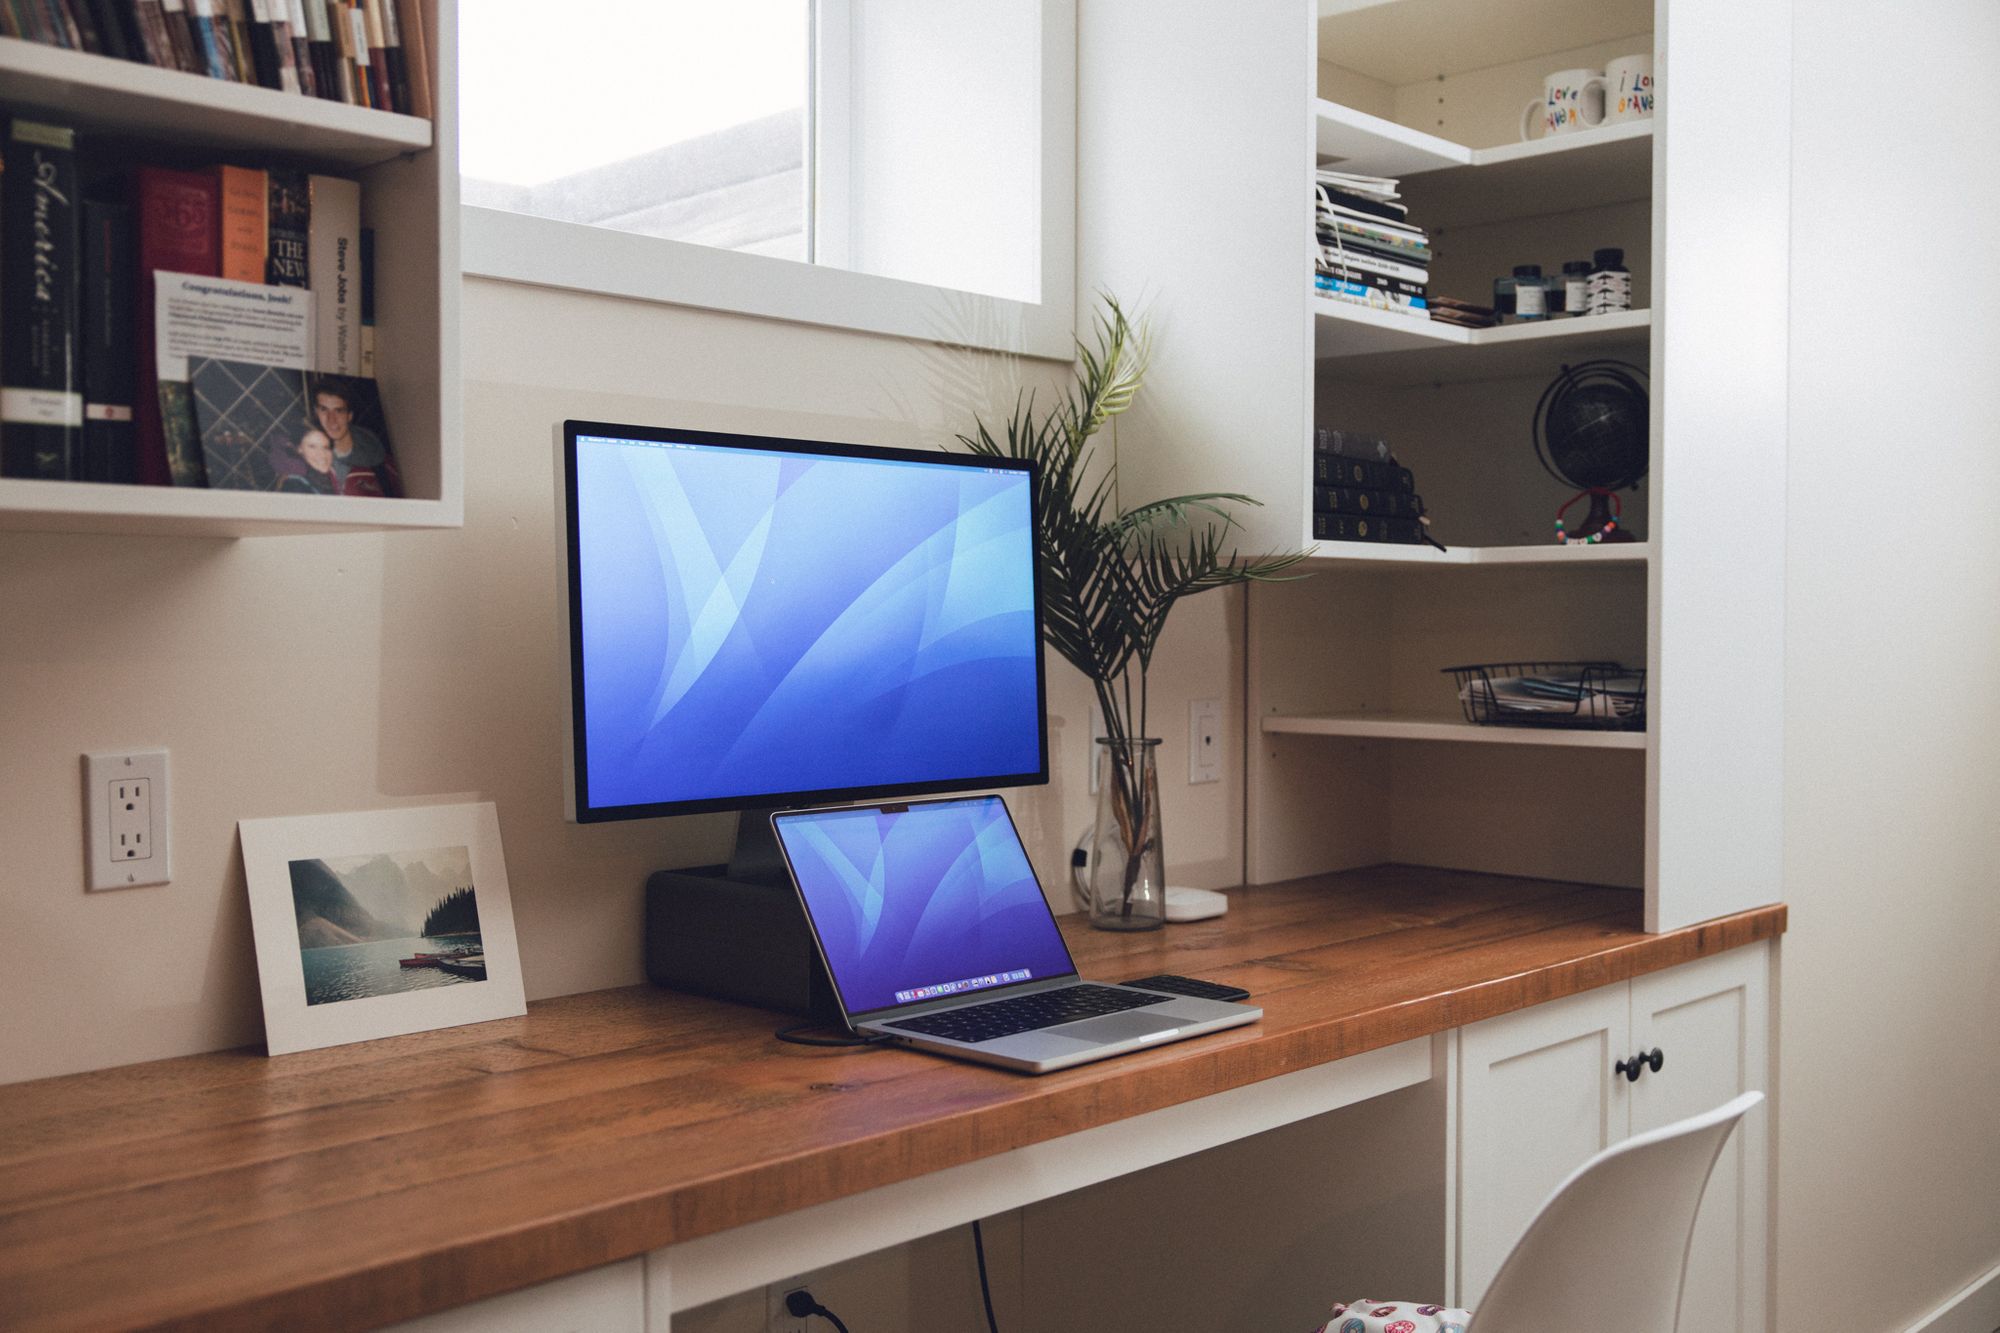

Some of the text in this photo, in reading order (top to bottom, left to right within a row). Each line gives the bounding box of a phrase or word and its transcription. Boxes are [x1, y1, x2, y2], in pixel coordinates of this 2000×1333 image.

[1548, 85, 1578, 106] Love
[34, 151, 69, 300] America
[275, 239, 305, 259] THE
[337, 236, 347, 272] Steve
[182, 281, 266, 301] Congratulations,
[337, 274, 347, 304] Jobs
[336, 307, 346, 321] by
[337, 325, 347, 362] Walter
